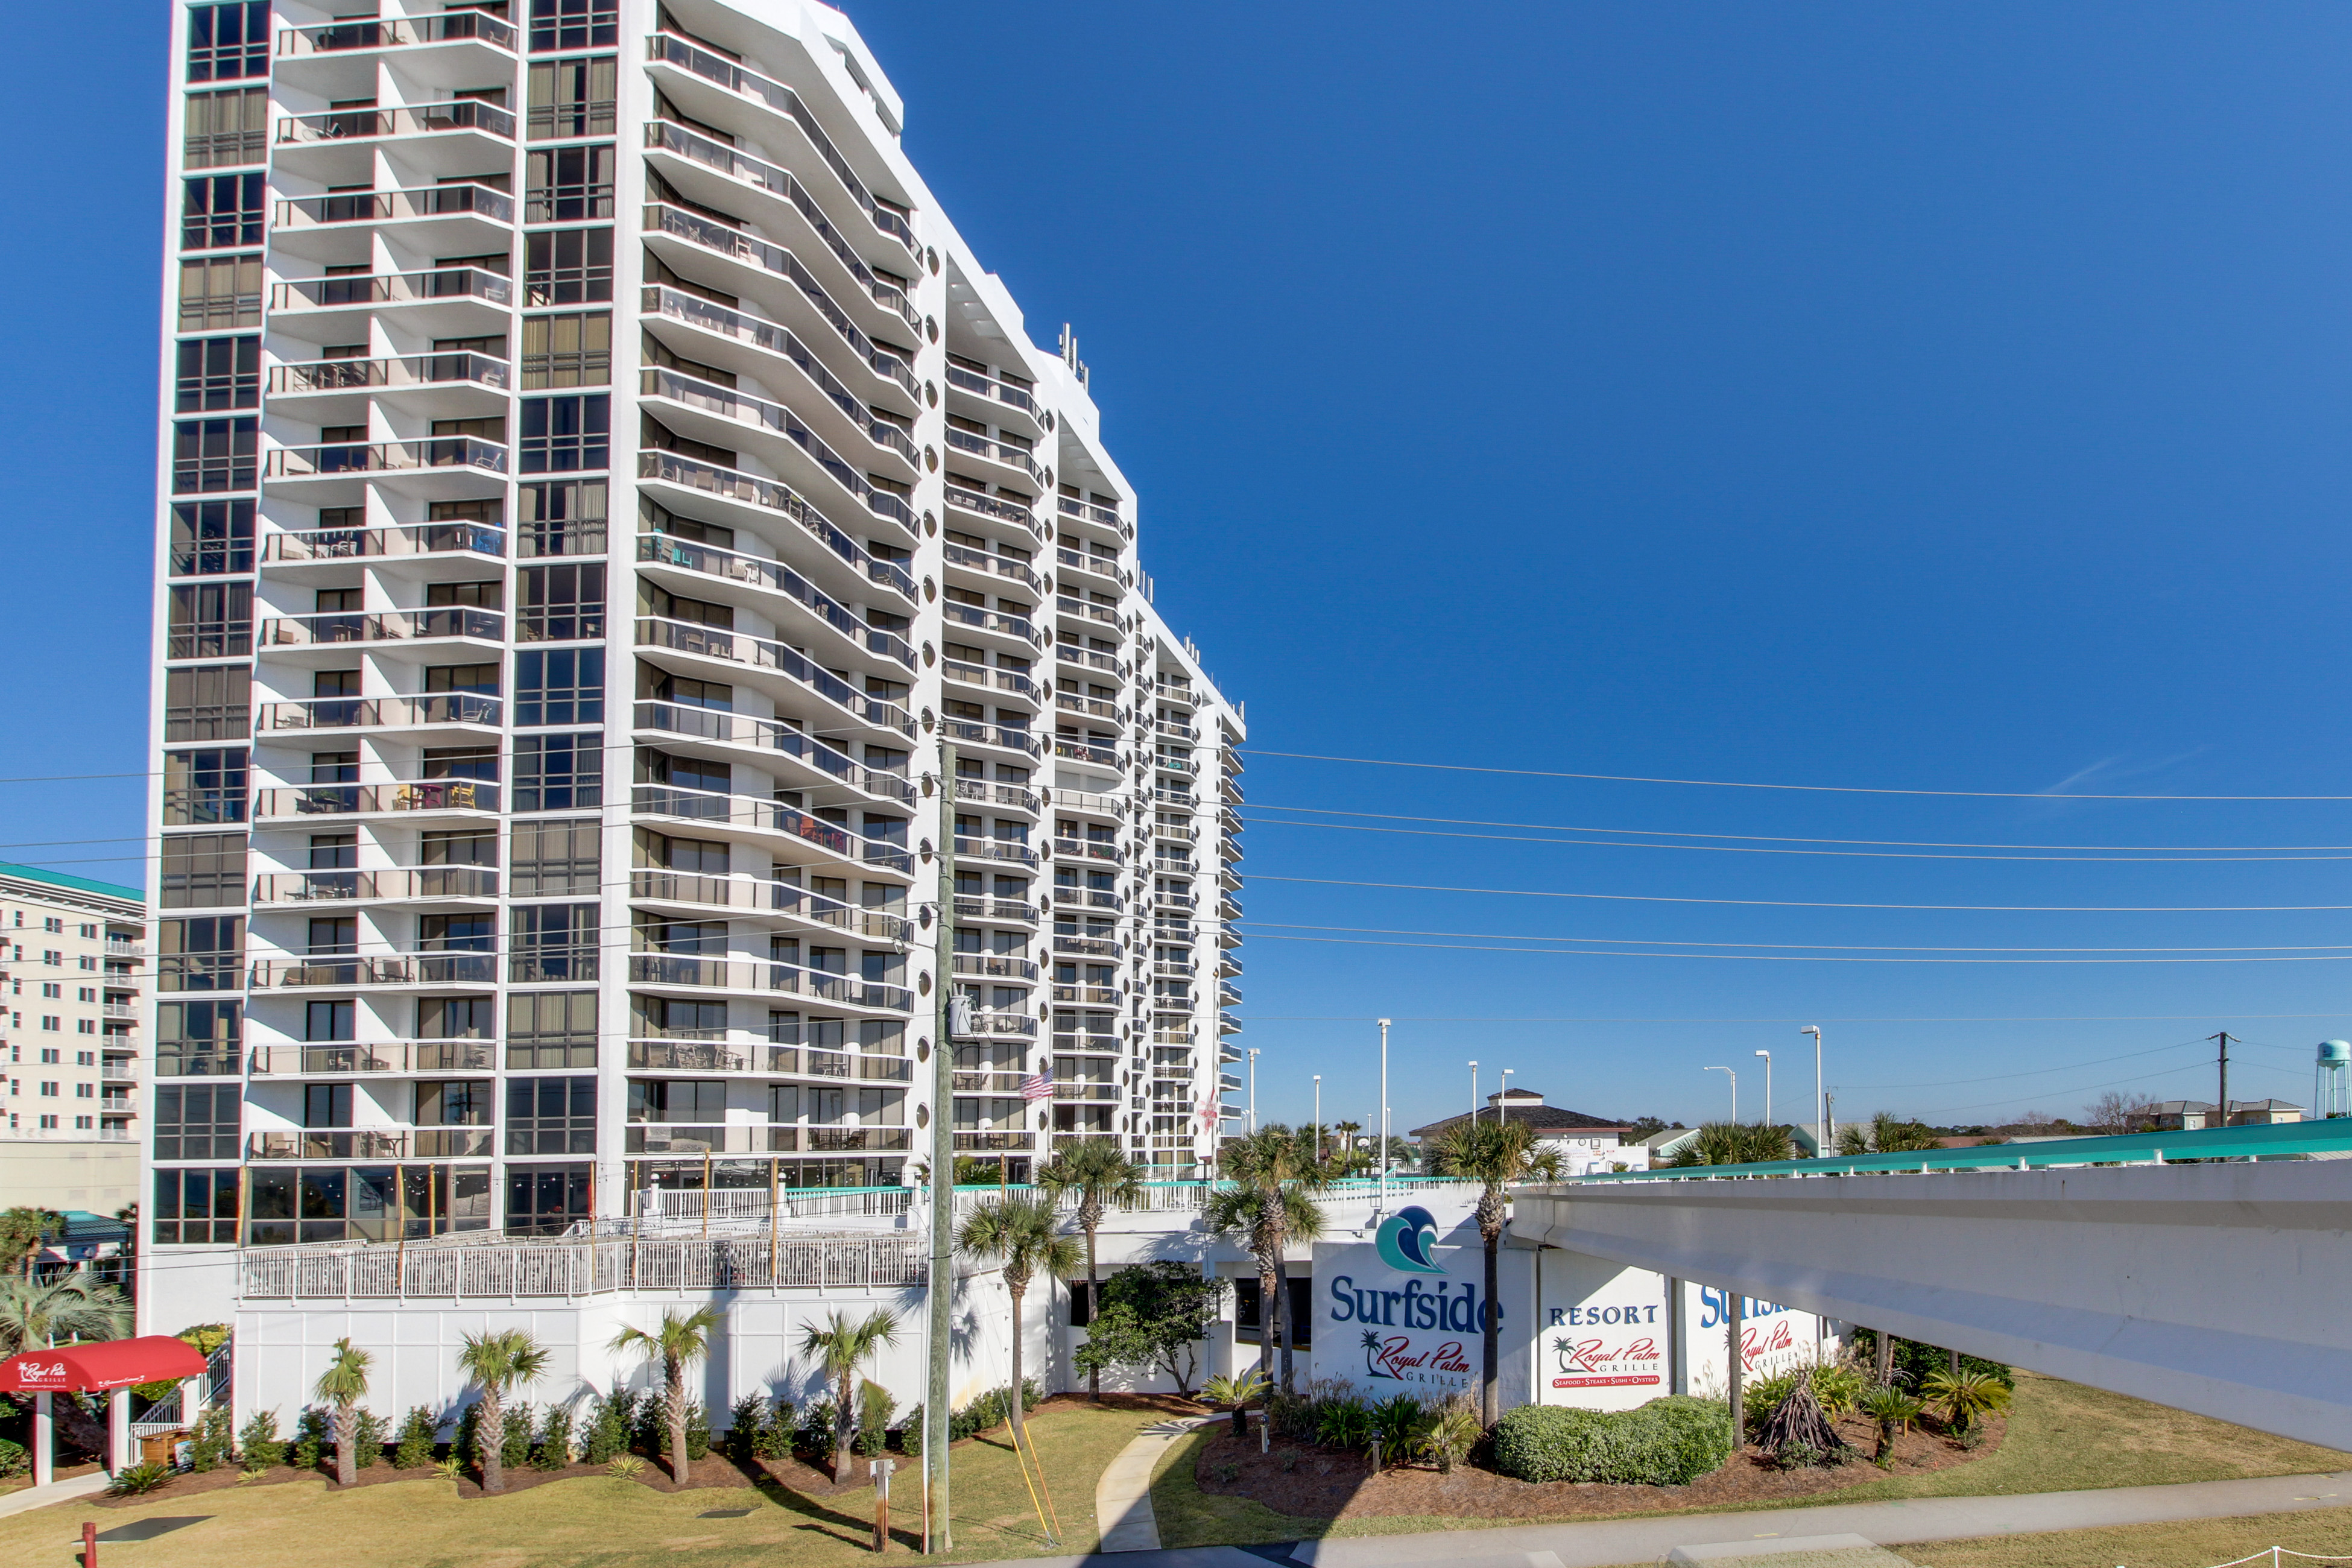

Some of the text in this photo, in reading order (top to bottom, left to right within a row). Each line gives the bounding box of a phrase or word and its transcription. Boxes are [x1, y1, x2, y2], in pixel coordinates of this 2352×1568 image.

[1549, 1305, 1658, 1326] RESORT
[1569, 1338, 1660, 1372] Royal Palm
[1740, 1320, 1792, 1371] Royal Palm
[1376, 1336, 1470, 1380] Royal Palm
[1600, 1364, 1658, 1372] GRILLE
[1755, 1352, 1791, 1369] GRILLE
[25, 1362, 49, 1382] Royal
[1406, 1371, 1468, 1388] GRILLE
